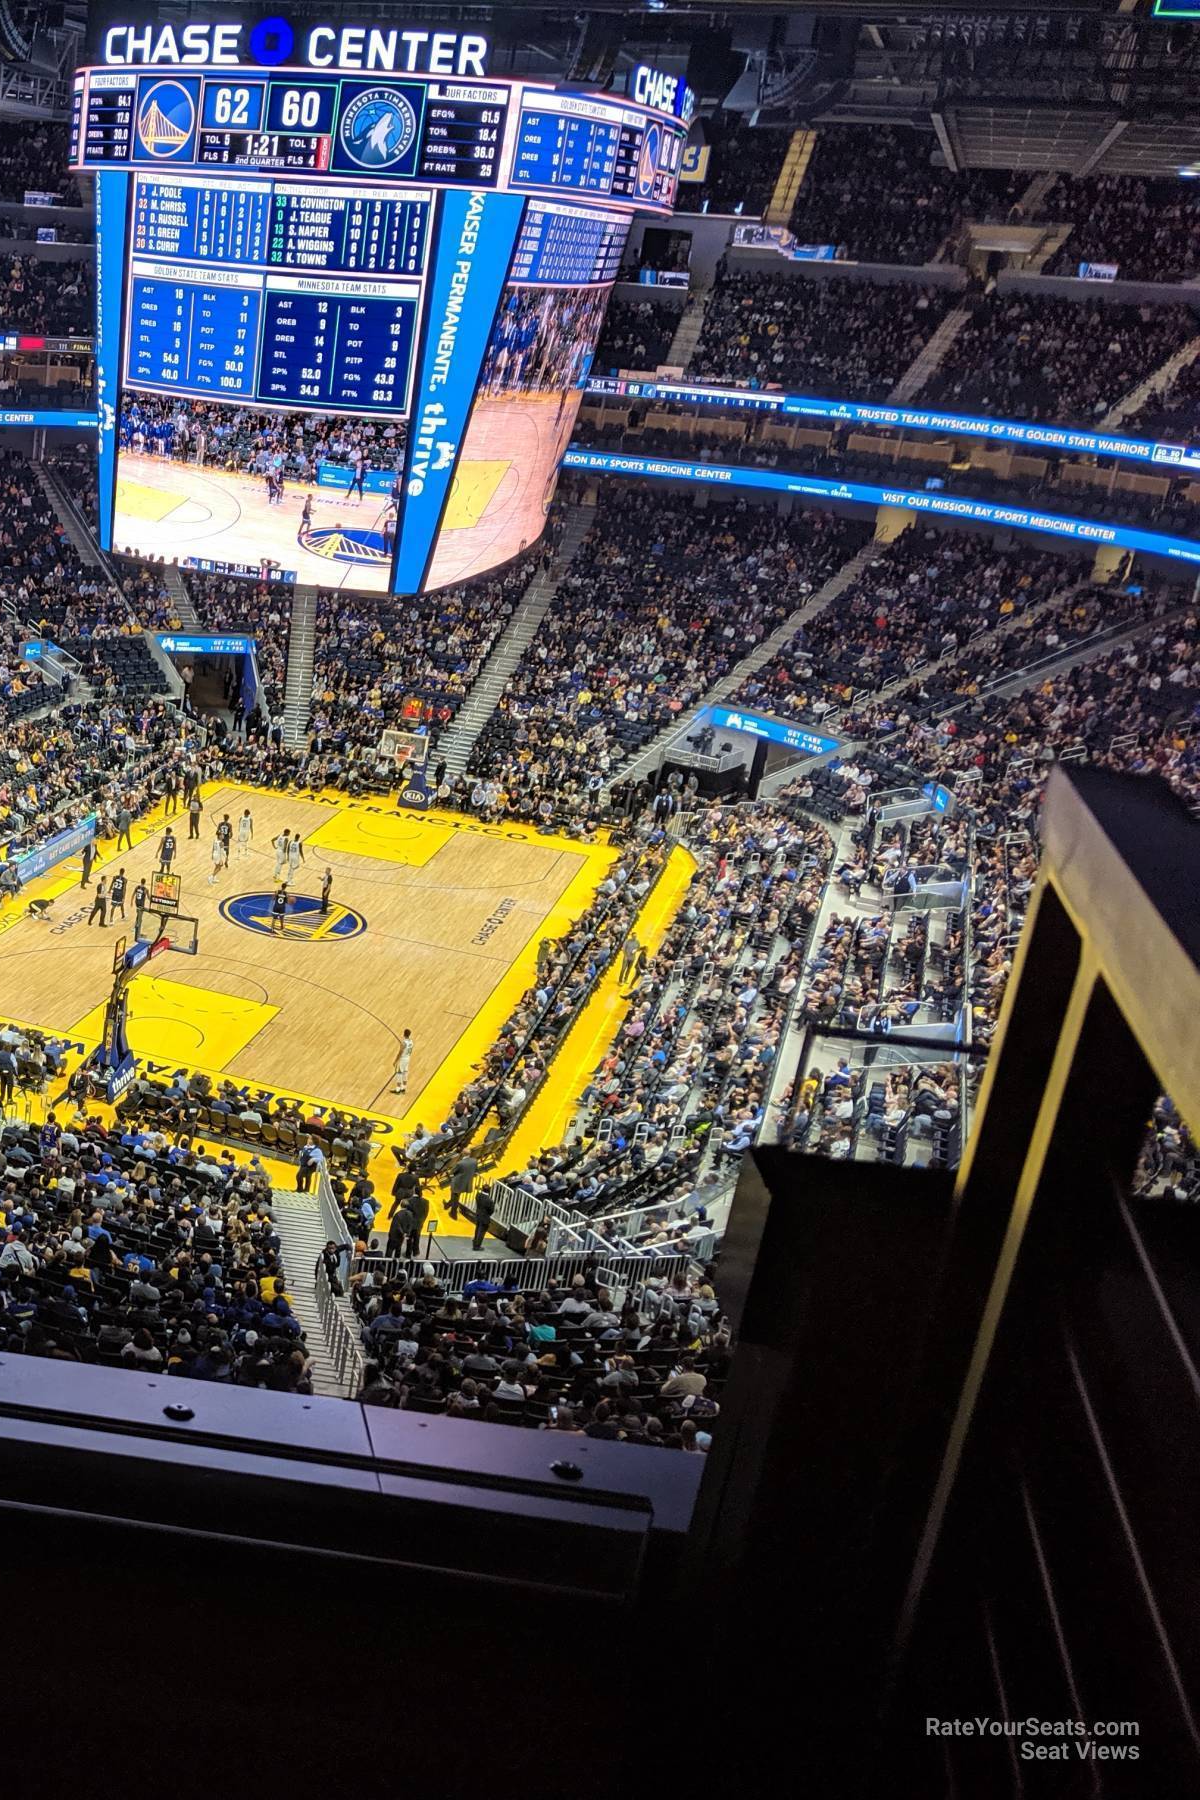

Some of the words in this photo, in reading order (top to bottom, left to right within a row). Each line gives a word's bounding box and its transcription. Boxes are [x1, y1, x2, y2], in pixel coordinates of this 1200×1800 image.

[105, 24, 242, 64] CHASE
[308, 27, 488, 76] CENTER
[462, 89, 498, 101] FACTORS
[635, 66, 678, 113] CHASE
[215, 88, 250, 124] 62
[281, 90, 321, 128] 60
[344, 93, 379, 137] MINNESOTA
[384, 92, 412, 155] TIMBERWOLVES
[432, 110, 455, 119] EFG%
[481, 111, 500, 124] 61.5
[205, 135, 220, 144] TOL
[224, 134, 230, 146] 5
[429, 127, 447, 137] TO%
[479, 129, 497, 142] 18.4
[246, 135, 279, 156] 1:21
[289, 139, 306, 148] TOL
[311, 138, 317, 149] 5
[204, 152, 218, 160] FLS
[223, 151, 229, 162] 5
[427, 145, 456, 155] OREB%
[474, 147, 495, 159] 36.0
[250, 158, 285, 166] QUARTER
[288, 156, 303, 164] FLS
[309, 155, 314, 166] 4
[424, 163, 434, 171] FT
[436, 164, 456, 173] RATE
[480, 165, 492, 177] 25
[160, 188, 182, 198] POOLE
[160, 201, 186, 213] CHRISS
[300, 198, 345, 210] COVINGTON
[158, 214, 188, 227] RUSSELL
[300, 212, 332, 224] TEAGUE
[458, 191, 486, 255] KAISER
[158, 228, 180, 239] GREEN
[299, 226, 329, 238] NAPIER
[156, 241, 179, 252] CURRY
[298, 241, 334, 252] WIGGINS
[297, 254, 327, 266] TOWNS
[154, 266, 178, 276] GOLDEN
[179, 268, 198, 279] STATE
[200, 272, 216, 280] TEAM
[218, 273, 239, 283] STATS
[298, 280, 339, 291] MINNESOTA
[341, 283, 361, 292] TEAM
[363, 285, 386, 294] STATS
[318, 302, 328, 313] 12
[390, 324, 400, 334] 12
[429, 260, 472, 392] PERMANENTE.
[315, 336, 324, 347] 14
[302, 368, 321, 380] 52.0
[374, 374, 394, 384] 43.8
[300, 385, 319, 396] 34.8
[373, 390, 392, 401] 83.3
[856, 408, 898, 422] TRUSTED
[901, 414, 929, 425] TEAM
[931, 418, 990, 434] PHYSICIANS
[992, 425, 1005, 434] OF
[1007, 427, 1024, 438] THE
[1026, 430, 1066, 444] GOLDEN
[1068, 436, 1095, 448] STATE
[1098, 440, 1150, 455] WARRIORS
[408, 403, 448, 496] thrive
[590, 457, 608, 466] BAY
[610, 459, 644, 470] SPORTS
[647, 464, 692, 476] MEDICINE
[694, 469, 732, 480] CENTER
[882, 493, 905, 504] VISIT
[908, 497, 928, 507] OUR
[932, 500, 973, 514] MISSION
[975, 506, 992, 517] BAY
[994, 511, 1028, 524] SPORTS
[1030, 516, 1075, 532] MEDICINE
[1077, 525, 1116, 540] CENTER
[788, 729, 800, 738] GET
[803, 734, 822, 744] CARE
[784, 737, 799, 745] LIKE
[809, 744, 822, 753] PRO
[406, 792, 423, 802] KIA
[286, 791, 339, 805] SAN
[348, 802, 528, 840] FRANCISCO
[50, 912, 83, 935] CHASE
[471, 924, 498, 945] CHASE
[492, 898, 517, 918] CENTER
[112, 1065, 136, 1095] thrive
